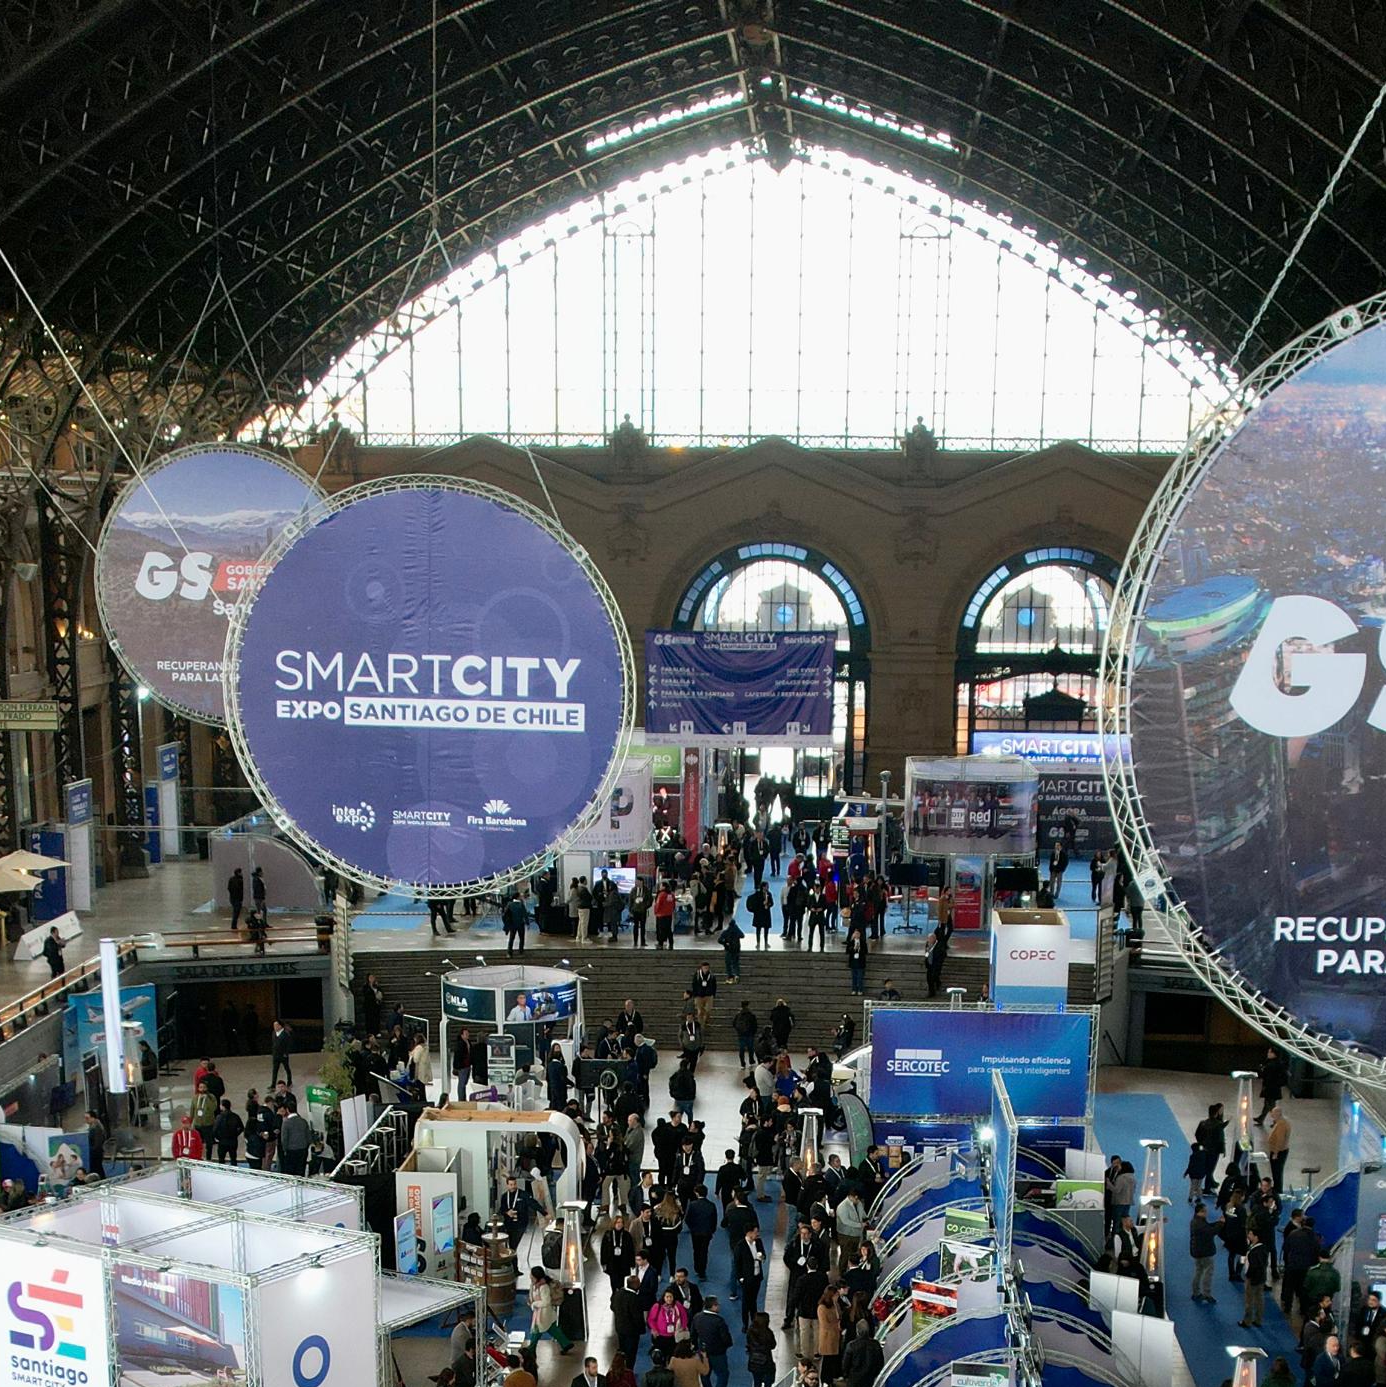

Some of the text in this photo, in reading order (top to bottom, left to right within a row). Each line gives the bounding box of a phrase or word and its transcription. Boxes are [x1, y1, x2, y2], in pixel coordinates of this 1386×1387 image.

[135, 551, 213, 601] GS
[703, 632, 776, 643] SMARTCITY
[171, 673, 204, 683] PARA
[275, 649, 582, 699] SMARTCITY
[275, 700, 580, 727] EXPO SANTIAGO DE CHILE
[1037, 779, 1105, 794] MARTCIT
[332, 803, 362, 817] inter
[392, 810, 451, 821] SMARTCITY
[335, 814, 368, 827] expo
[467, 815, 527, 827] Fira Barcelona
[1010, 948, 1056, 961] COPEC
[174, 963, 298, 977] SALA DE LAS ARTES
[886, 1059, 950, 1073] SERCOTEC
[981, 1055, 1071, 1065] Impulsando eficiencia
[967, 1066, 1071, 1076] para inteligentes
[121, 1274, 142, 1287] Medio
[10, 1354, 89, 1386] santiago
[12, 1371, 43, 1387] SMART
